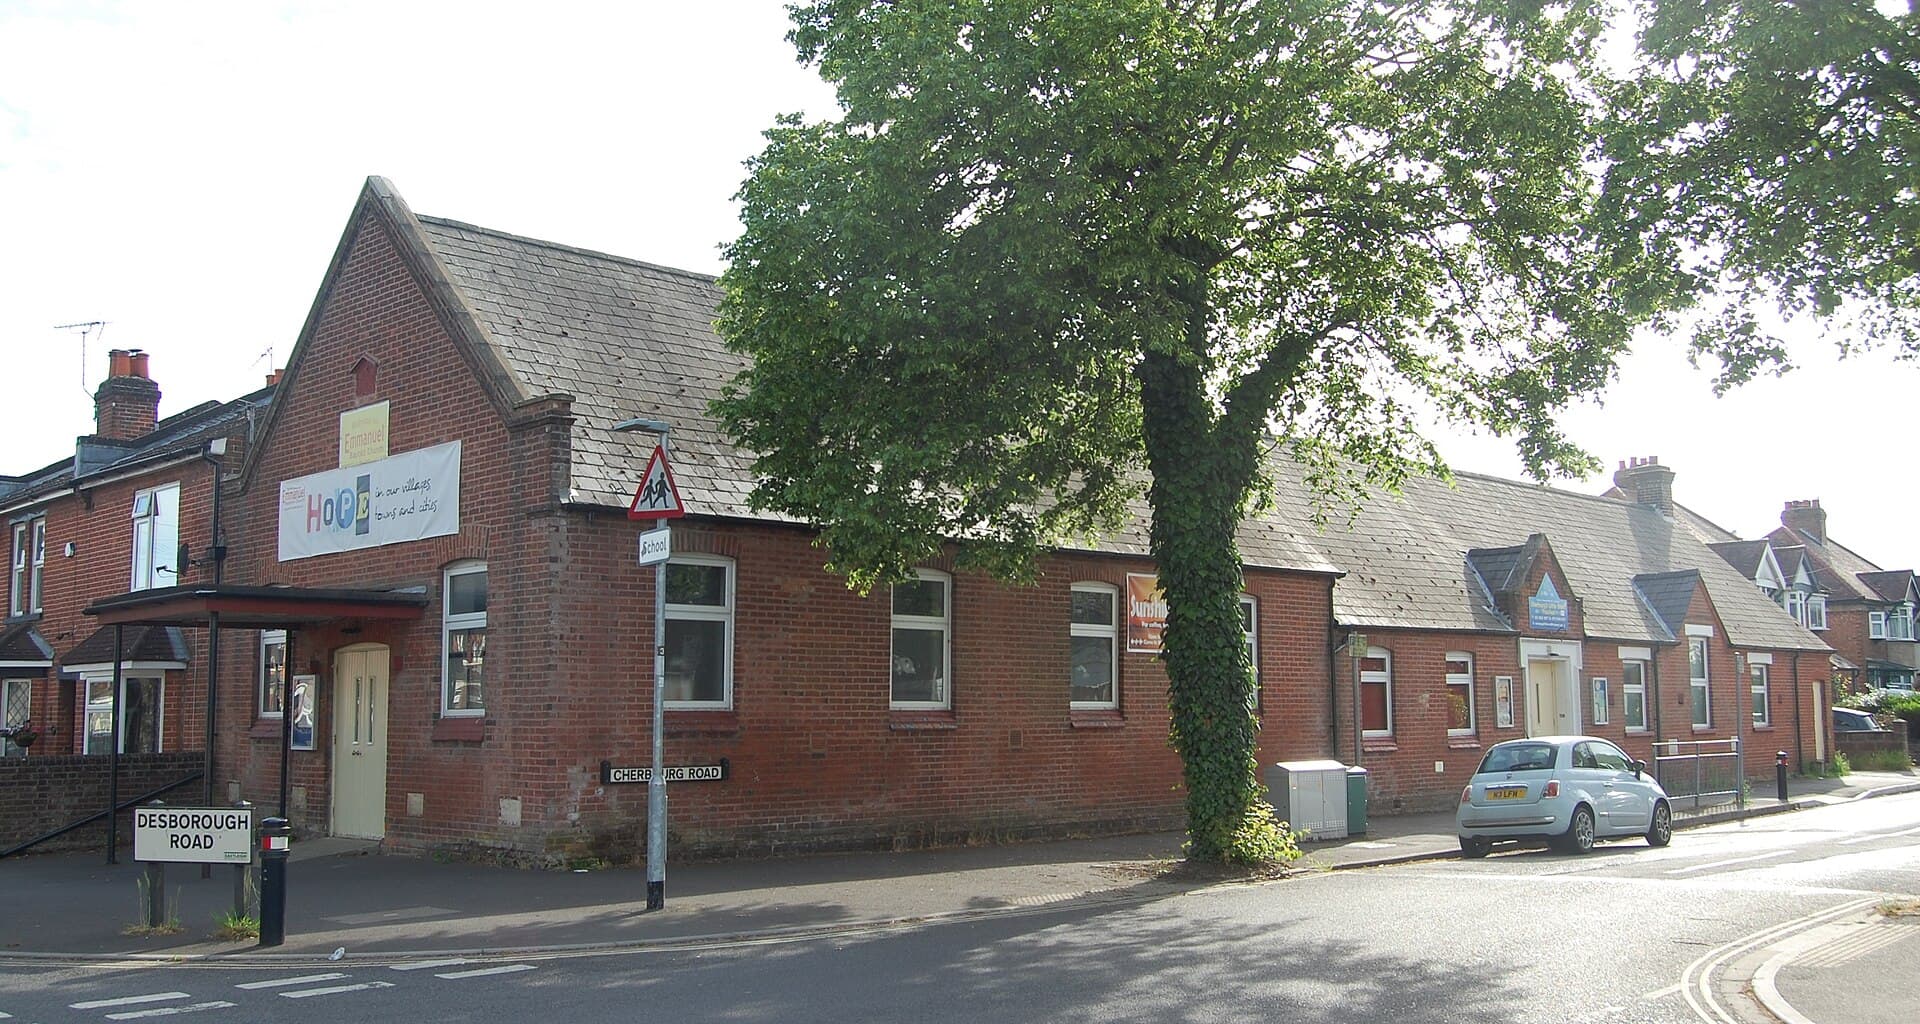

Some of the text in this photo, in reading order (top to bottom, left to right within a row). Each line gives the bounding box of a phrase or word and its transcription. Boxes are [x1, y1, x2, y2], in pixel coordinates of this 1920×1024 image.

[344, 424, 385, 454] Emmanuel
[386, 488, 400, 497] our
[402, 477, 431, 496] villages
[375, 496, 438, 521] towns and cities
[641, 537, 666, 557] School
[613, 767, 719, 782] CHERBURG ROAD
[138, 813, 248, 830] DESBOROUGH
[170, 834, 214, 849] ROAD
